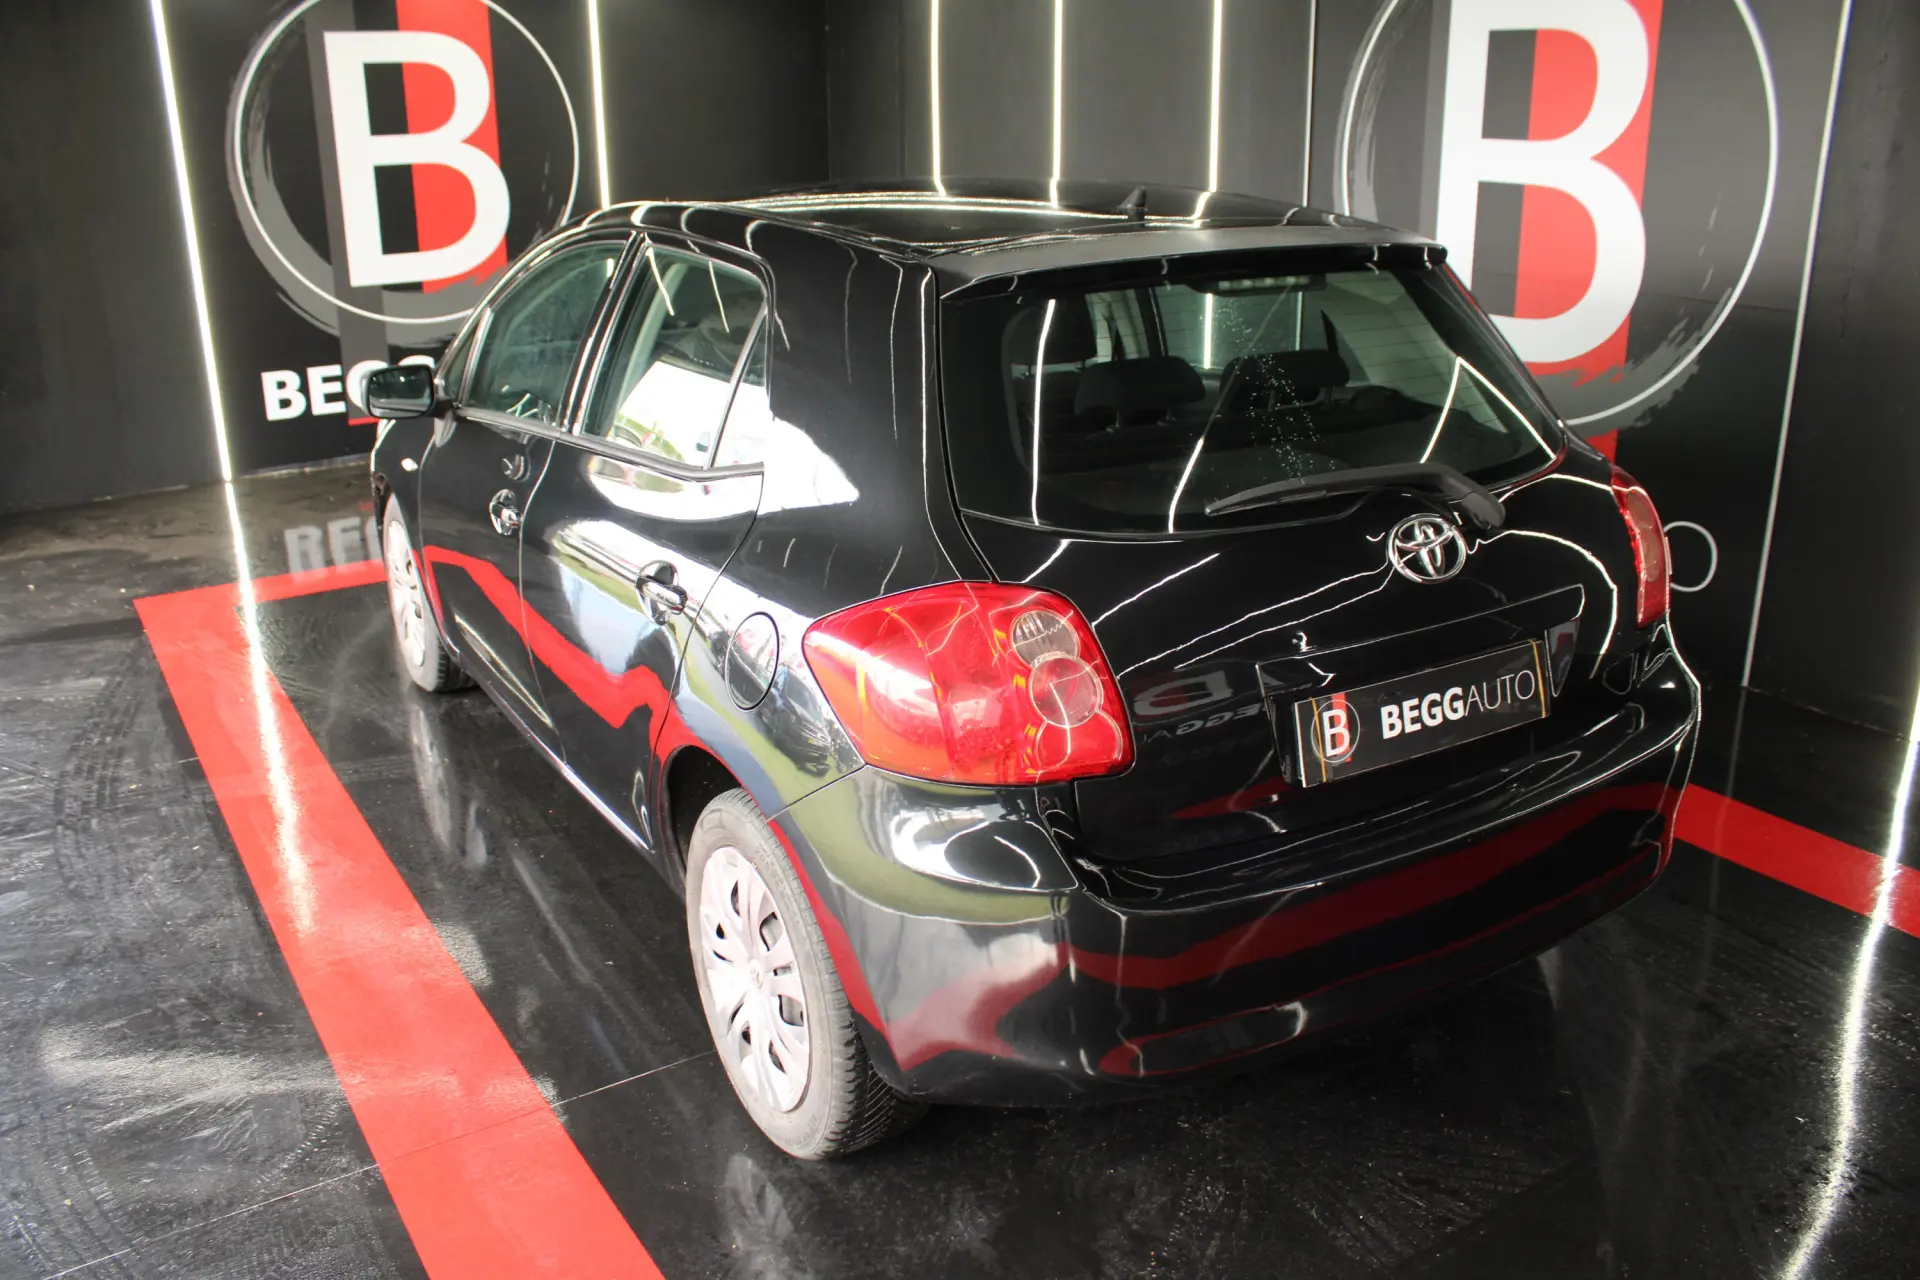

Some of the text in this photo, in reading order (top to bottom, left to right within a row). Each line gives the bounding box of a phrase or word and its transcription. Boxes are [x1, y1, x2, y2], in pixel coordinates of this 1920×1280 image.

[323, 30, 511, 288] B
[1436, 0, 1649, 363] B
[260, 354, 435, 422] BE
[1322, 669, 1536, 758] B BEGGAUTO
